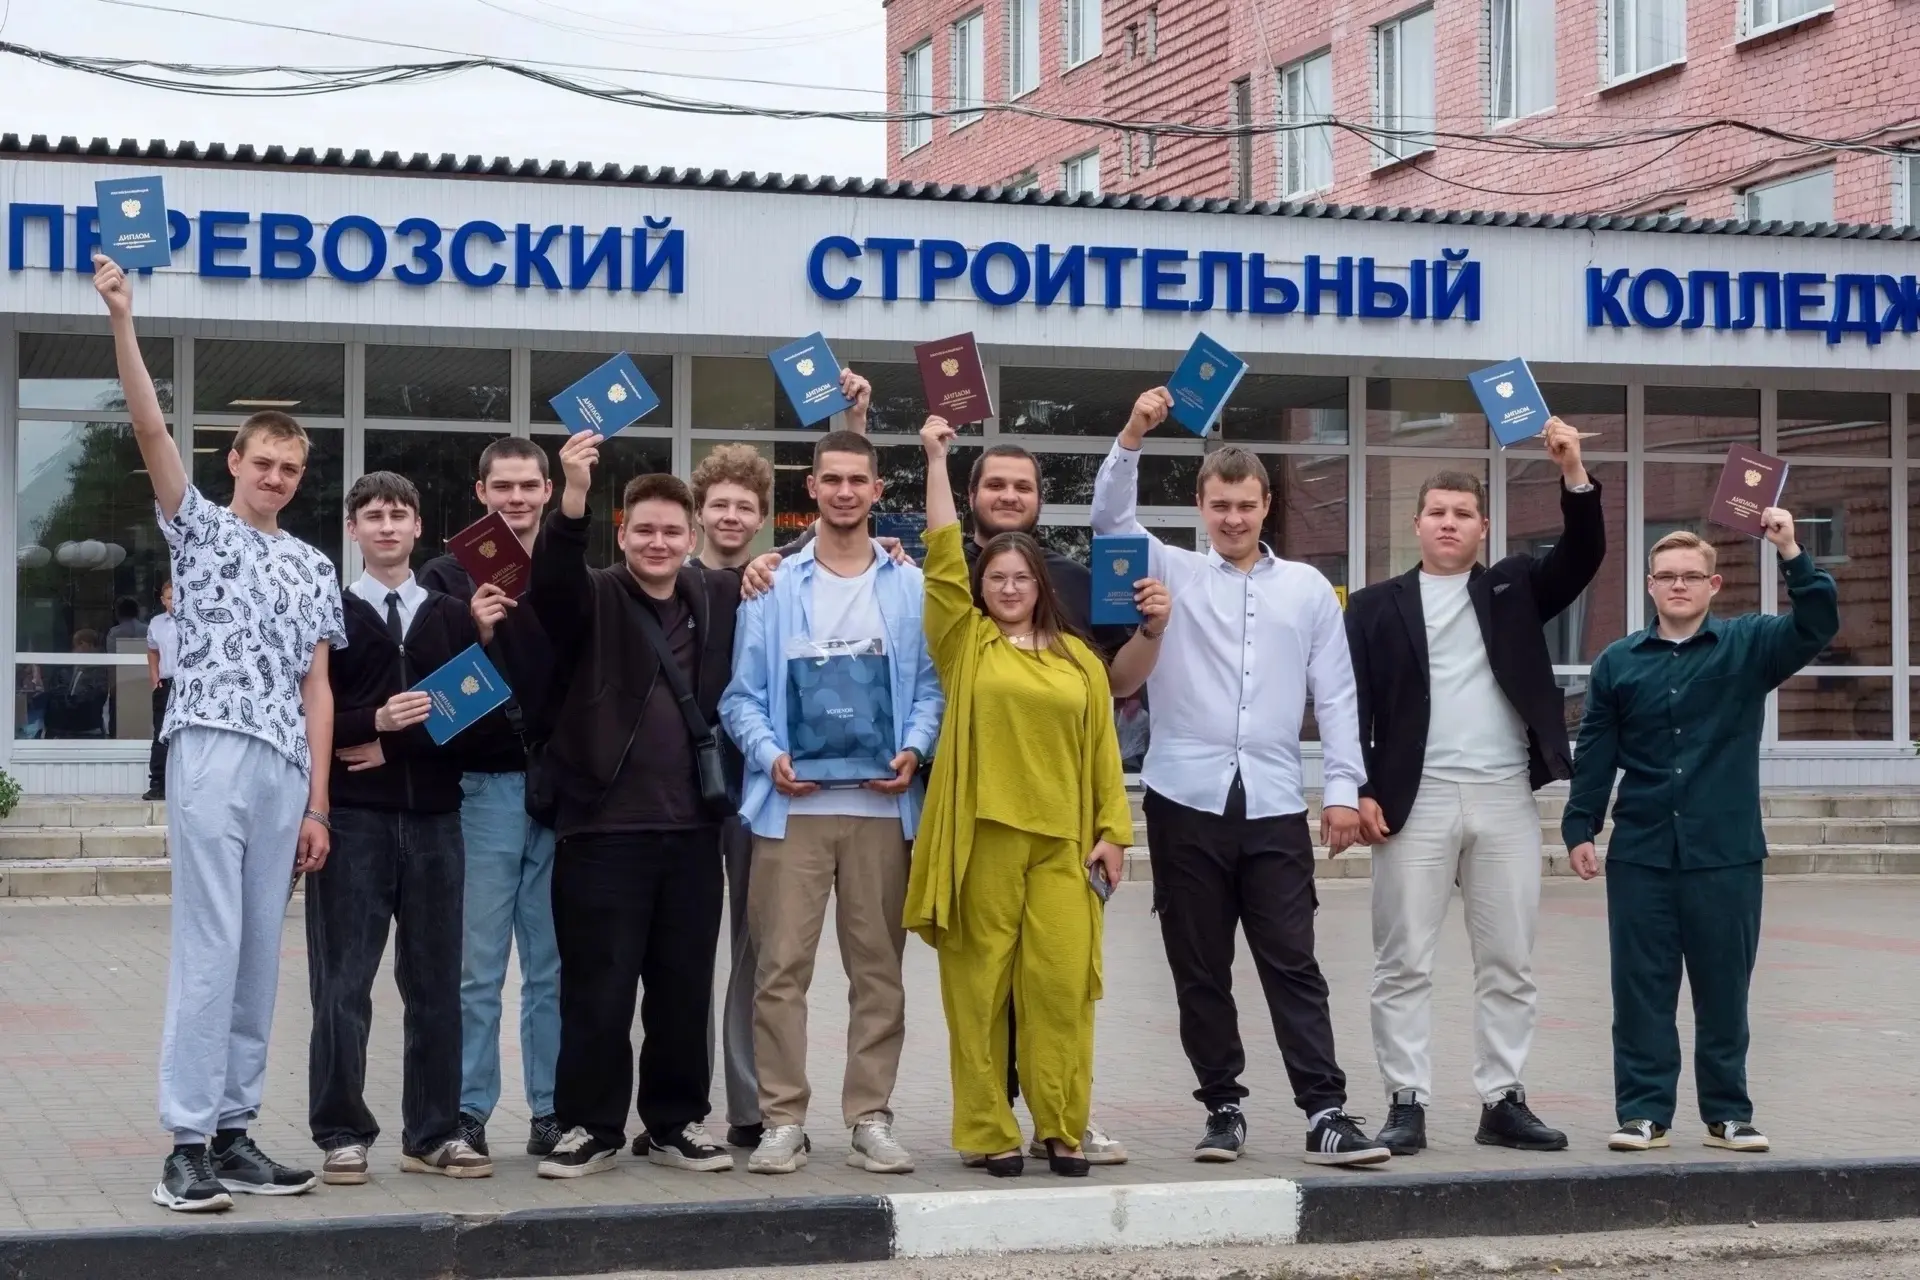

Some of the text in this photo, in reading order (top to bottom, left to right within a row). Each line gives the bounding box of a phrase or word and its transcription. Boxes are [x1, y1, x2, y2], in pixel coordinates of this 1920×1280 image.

[118, 232, 151, 242] ДИПЛОМ
[807, 235, 1481, 322] СТРОИТЕЛЬНЫЙ
[1586, 267, 1920, 345] КОЛЛЕДЖ
[805, 383, 831, 399] ДИПЛОМ
[943, 388, 971, 401] ДИПЛОМ
[582, 397, 604, 424] ДИПЛОМ
[1504, 405, 1530, 420] ДИПЛОМ
[1731, 496, 1758, 510] ДИПЛОМ
